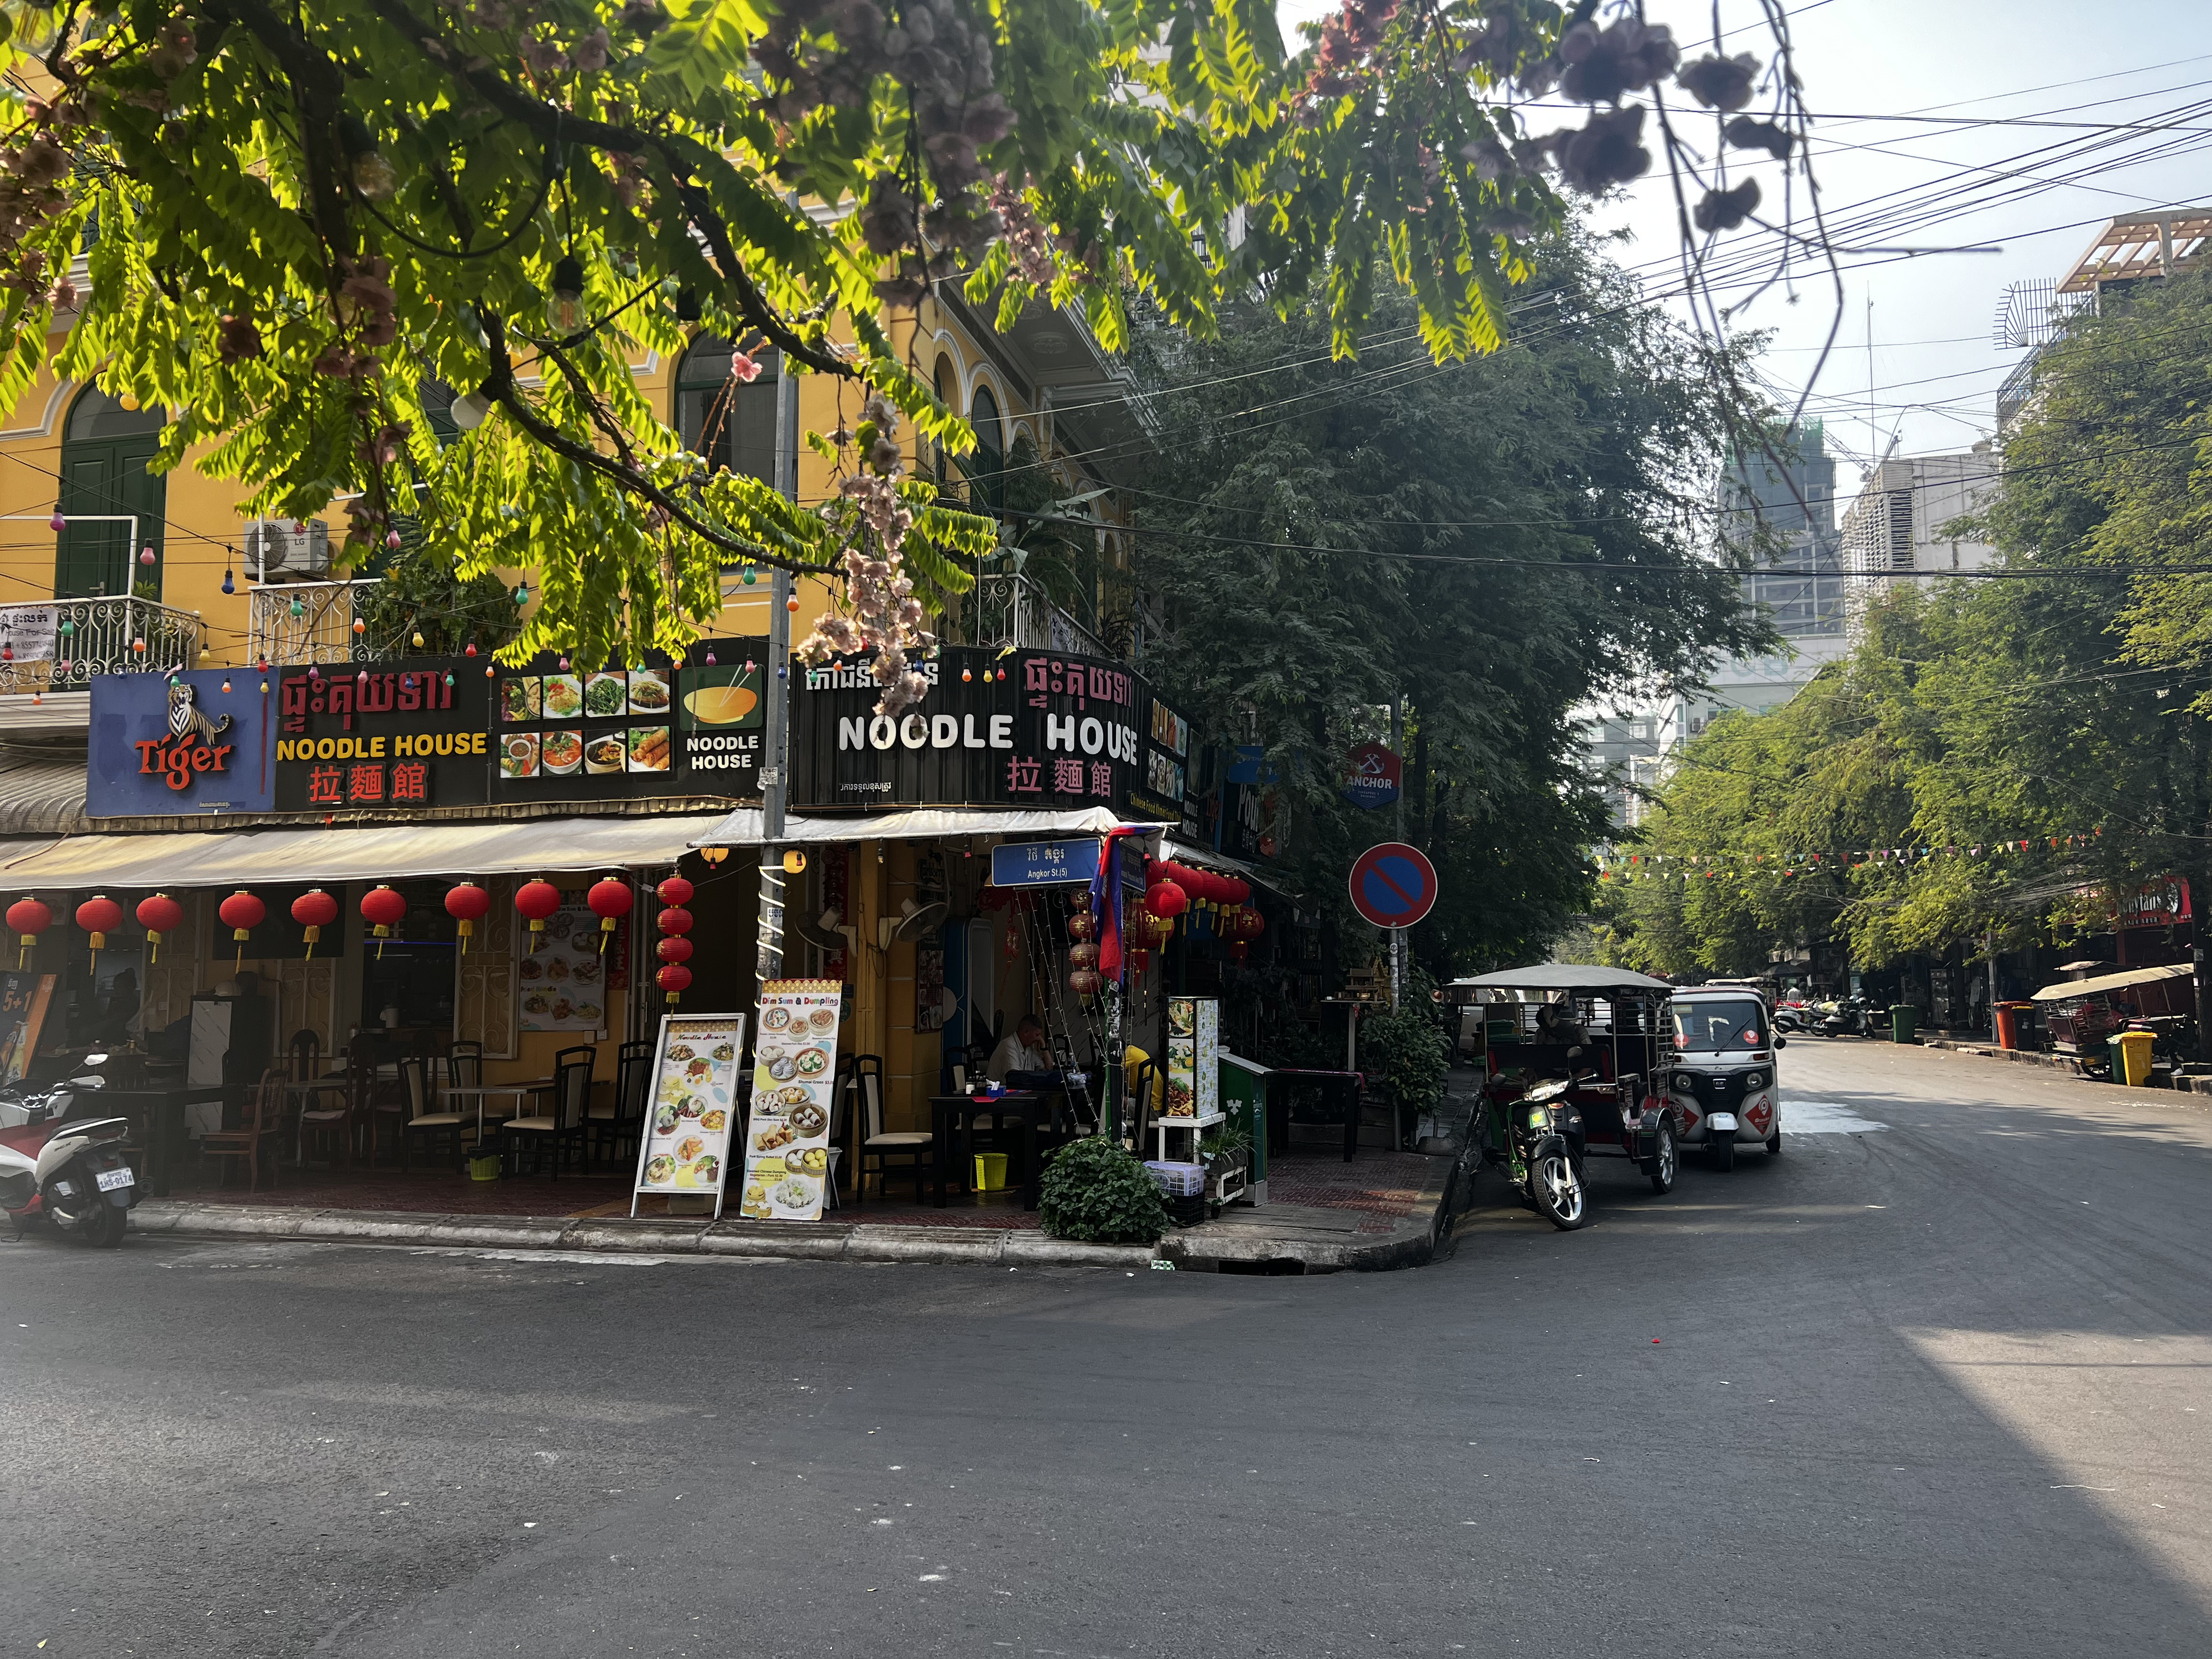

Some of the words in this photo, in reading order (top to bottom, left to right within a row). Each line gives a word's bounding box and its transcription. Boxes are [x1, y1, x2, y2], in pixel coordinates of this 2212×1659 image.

[277, 737, 386, 761] NOODLE
[395, 733, 487, 757] HOUSE
[687, 735, 759, 752] NOODLE
[839, 713, 1013, 751] NOODLE
[1047, 713, 1138, 766] HOUSE
[135, 733, 231, 790] Tiger
[691, 754, 752, 770] HOUSE
[310, 762, 426, 802] 拉麵館
[1007, 755, 1112, 798] 拉麵館
[1347, 775, 1392, 790] ANCHOR
[1130, 792, 1146, 810] Chinese
[1184, 800, 1198, 817] NOODLE
[1182, 818, 1198, 839] HOUSE
[1027, 869, 1050, 880] Angkor
[3, 991, 33, 1012] 5+1
[804, 997, 838, 1006] Dumpling
